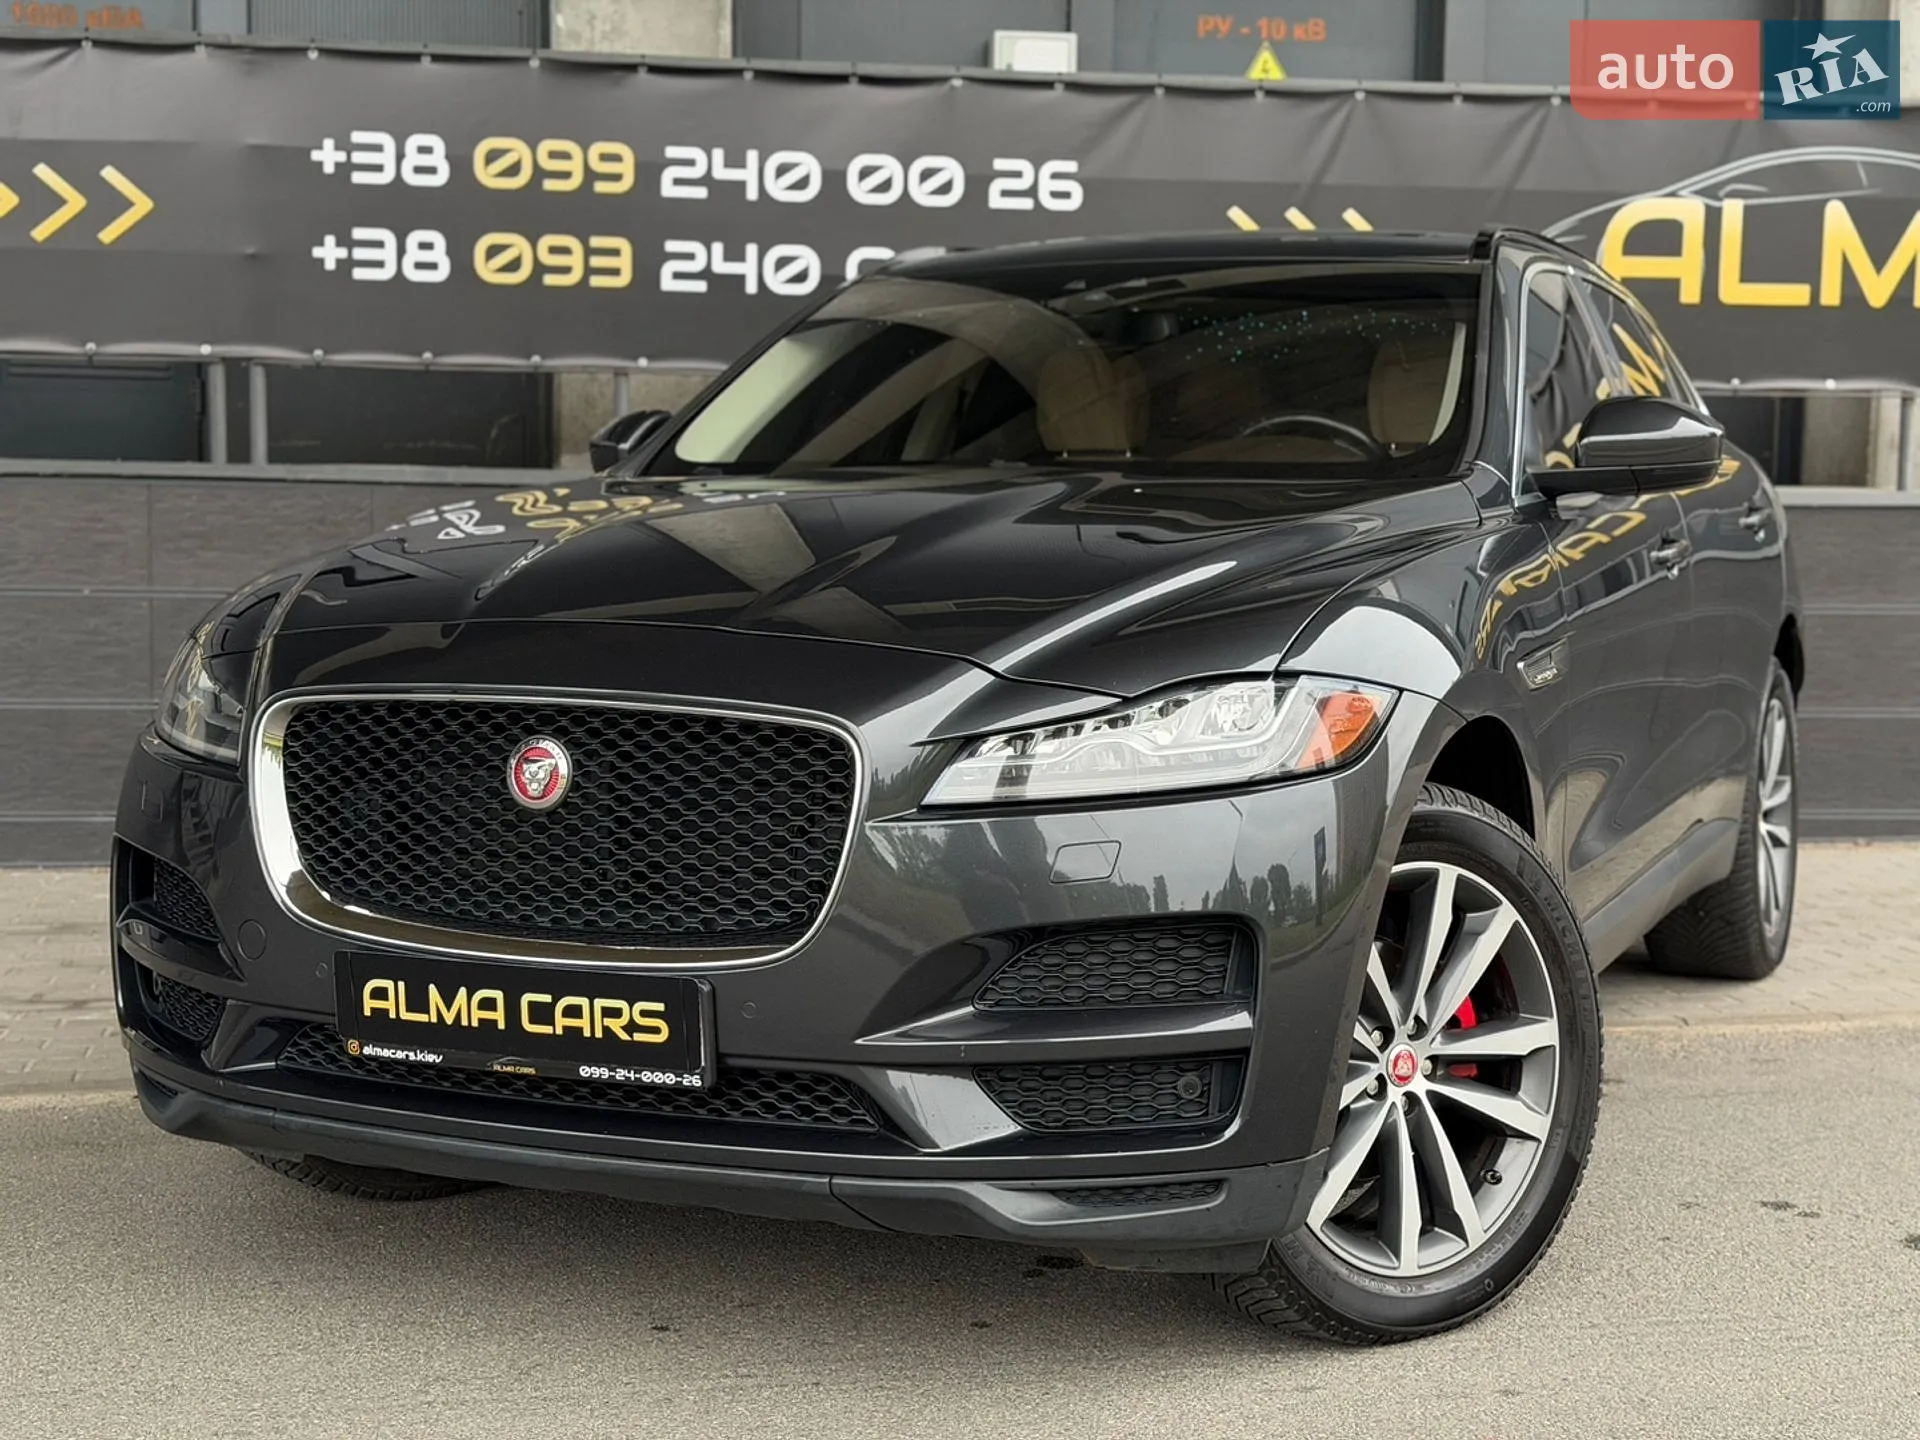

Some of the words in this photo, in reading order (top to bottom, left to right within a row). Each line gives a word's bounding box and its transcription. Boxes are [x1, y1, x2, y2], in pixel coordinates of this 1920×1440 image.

[1198, 15, 1233, 38] РУ
[1257, 17, 1287, 40] 10
[310, 130, 450, 187] +38
[474, 138, 635, 194] 099
[661, 145, 822, 202] 240
[846, 153, 965, 207] 00
[988, 157, 1084, 211] 26
[312, 227, 450, 282] +38
[474, 232, 633, 287] 093
[660, 240, 822, 295] 240
[363, 979, 505, 1029] ALMA
[521, 993, 669, 1043] CARS
[579, 1065, 702, 1087] 099-24-000-26
